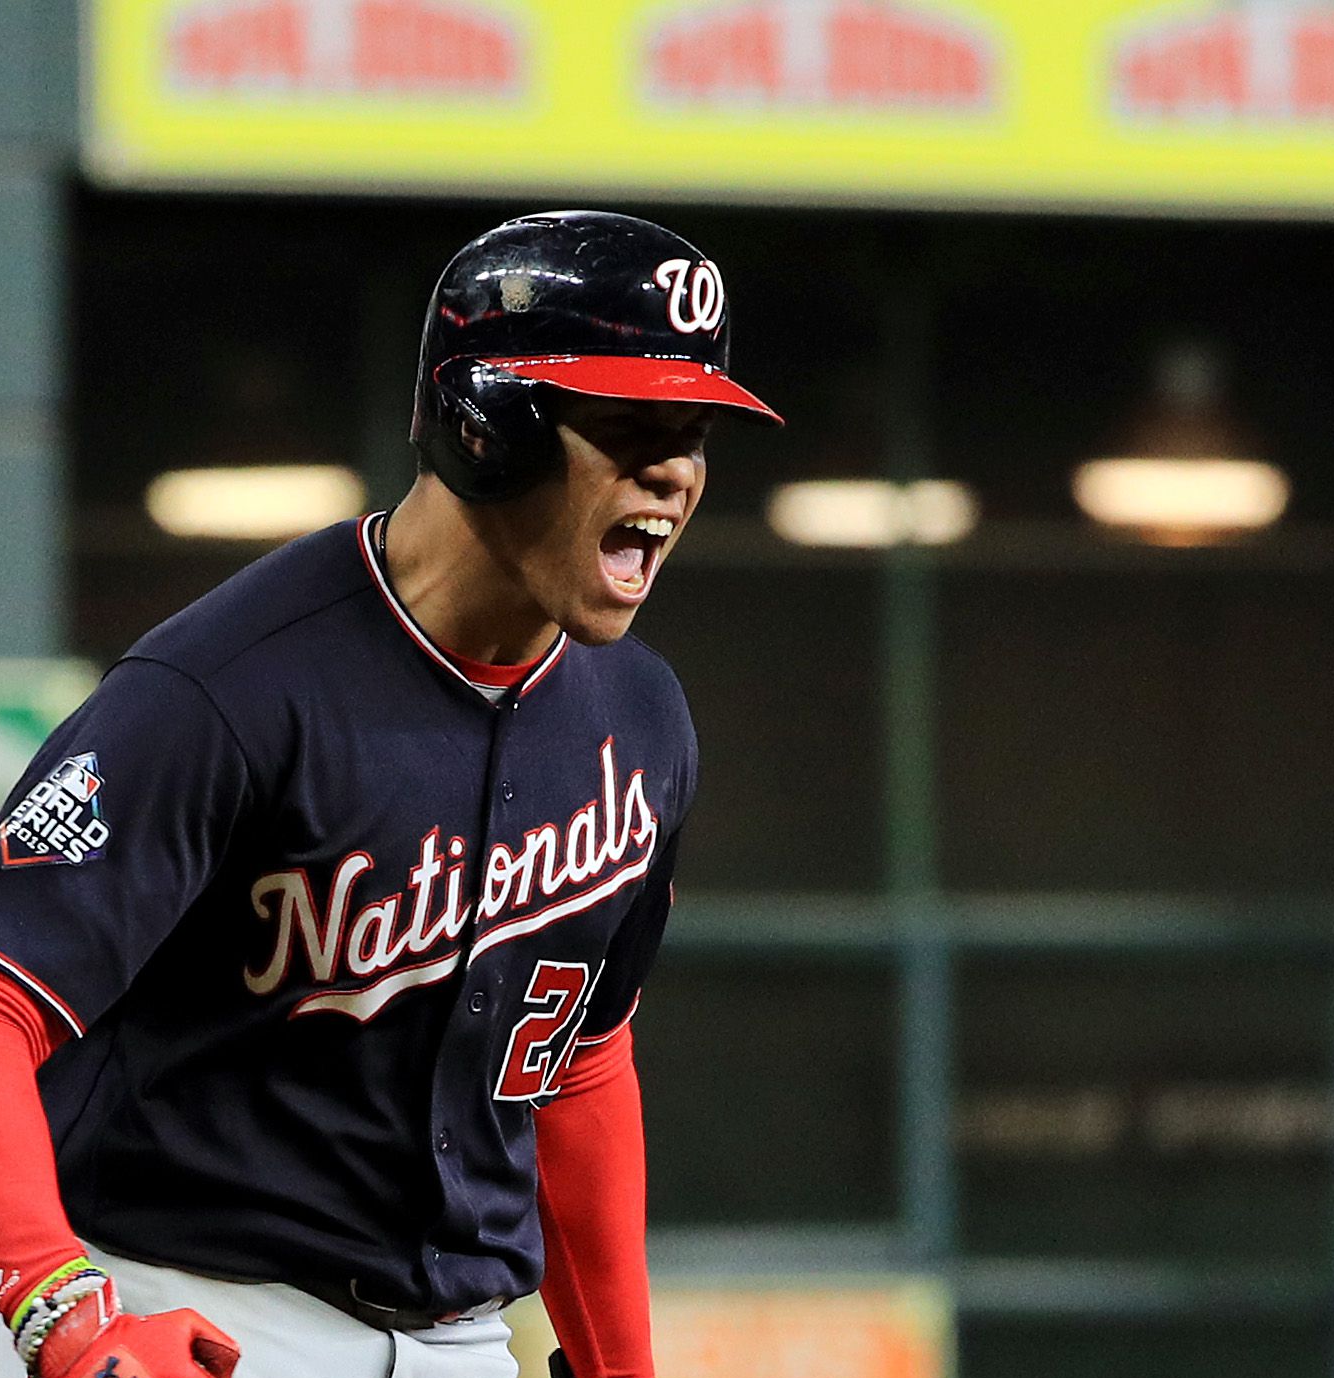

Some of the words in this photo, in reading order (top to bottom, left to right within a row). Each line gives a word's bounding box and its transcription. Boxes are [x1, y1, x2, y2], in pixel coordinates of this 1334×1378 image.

[653, 259, 726, 335] W
[5, 820, 50, 855] 2019
[11, 799, 90, 864] ERIES
[27, 781, 109, 848] ORLD
[243, 735, 659, 1012] Nationals
[493, 958, 606, 1110] 2
